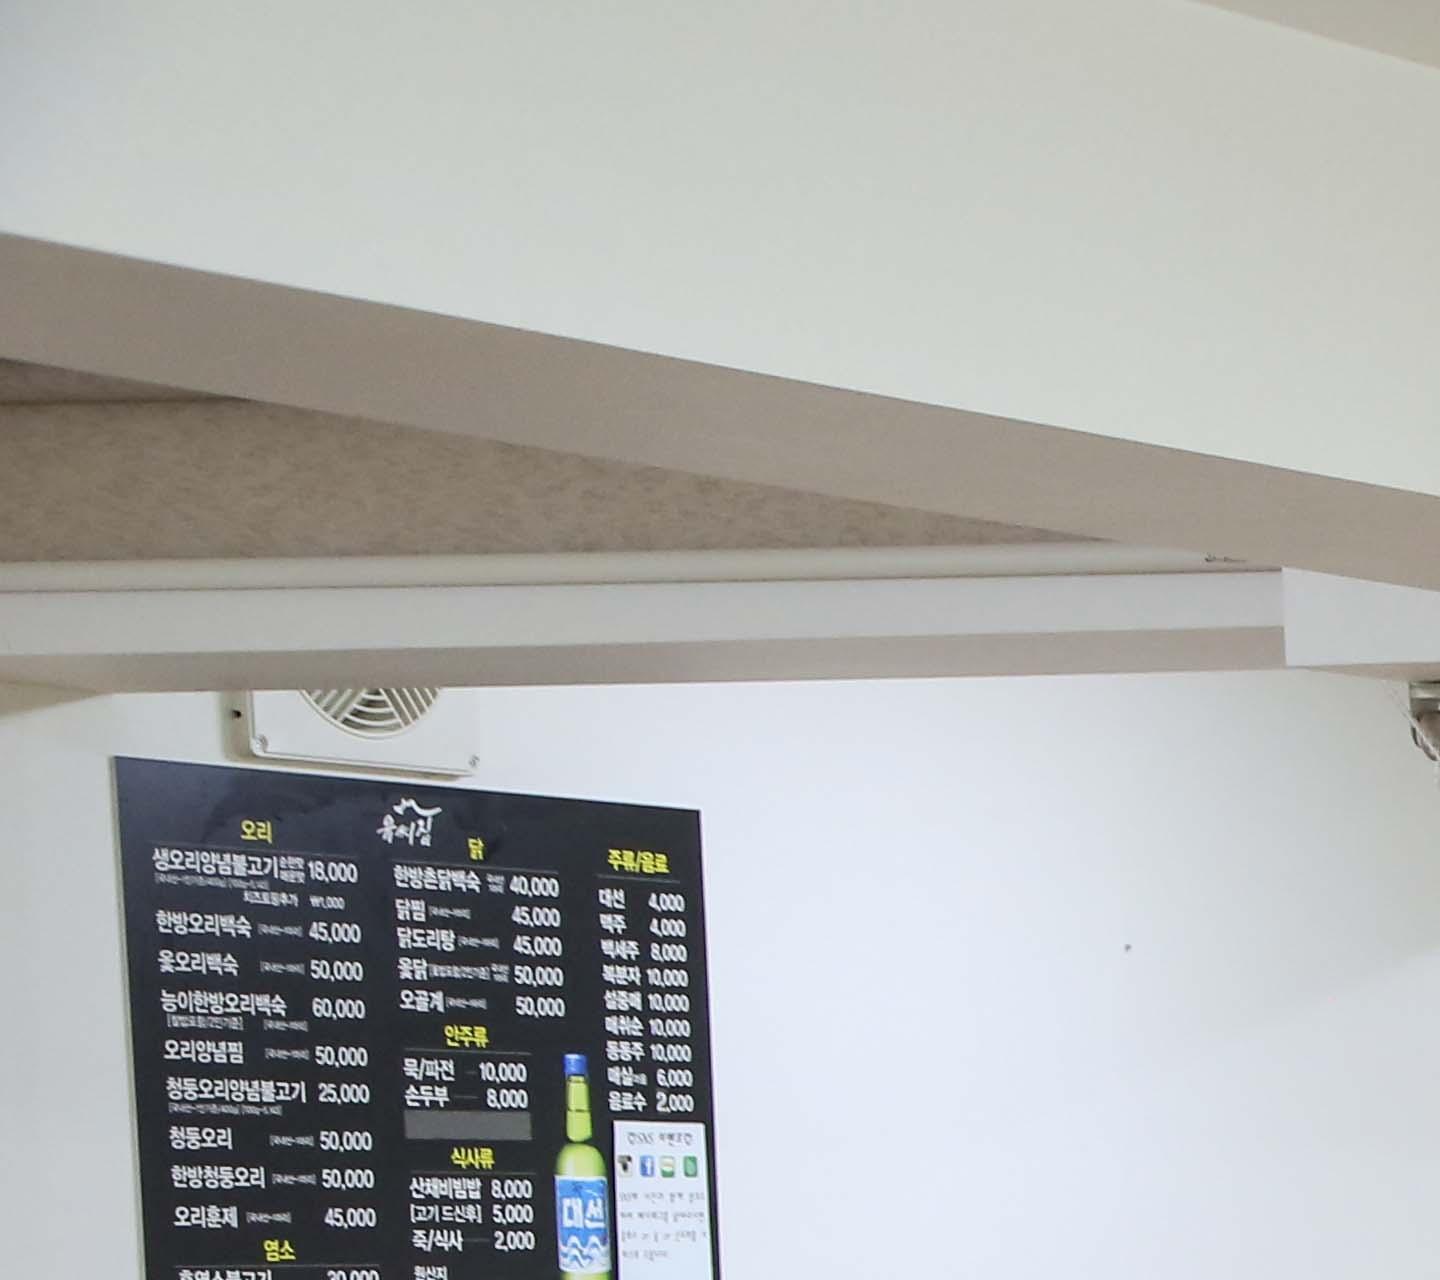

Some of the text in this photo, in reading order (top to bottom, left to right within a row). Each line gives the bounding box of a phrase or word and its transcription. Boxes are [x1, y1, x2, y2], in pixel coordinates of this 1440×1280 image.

[240, 819, 273, 844] 오리
[467, 836, 486, 861] 닭
[607, 848, 670, 874] 주류/음료
[152, 847, 278, 878] 생오리양념불고기
[308, 860, 358, 884] 18,000
[393, 864, 481, 894] 한방촌닭백숙
[509, 875, 560, 899] 40,000
[598, 888, 685, 912] 대선 4,000
[395, 898, 427, 922] 닭찜
[511, 905, 561, 928] 45,000
[155, 909, 252, 938] 한방오리백숙
[308, 921, 362, 944] 45,000
[649, 918, 687, 938] 4,000
[397, 926, 456, 952] 닭도리탕
[513, 935, 563, 957] 45,000
[650, 942, 688, 963] 8,000
[158, 949, 239, 976] 옻오리백숙
[310, 959, 364, 982] 50,000
[397, 957, 428, 981] 옻닭
[514, 965, 564, 988] 50,000
[646, 968, 689, 988] 10,000
[160, 989, 366, 1020] 능이한방오리백숙 60,000
[400, 989, 445, 1013] 오골계
[515, 996, 566, 1018] 50,000
[647, 993, 690, 1013] 10,000
[444, 1024, 490, 1048] 안주류
[648, 1018, 691, 1038] 10,000
[164, 1039, 244, 1064] 오리양념찜
[314, 1046, 368, 1068] 50,000
[650, 1043, 692, 1063] 10,000
[402, 1057, 527, 1084] 묵/파전 10,000
[656, 1069, 694, 1088] 6,000
[166, 1076, 371, 1105] 청둥오리양념불고기 25,000
[405, 1085, 529, 1109] 손두부 8,000
[608, 1089, 695, 1113] 음료수 2,000
[169, 1126, 233, 1150] 청둥오리
[319, 1130, 373, 1152] 50,000
[450, 1147, 495, 1169] 식사류
[170, 1164, 266, 1190] 한방청둥오리
[321, 1169, 375, 1190] 50,000
[409, 1176, 532, 1200] 산채비빔밥 8,000
[173, 1205, 238, 1229] 오리훈제
[324, 1207, 377, 1230] 45,000
[410, 1204, 438, 1224] [고기
[492, 1204, 534, 1225] 5,000
[562, 1197, 606, 1229] 대선
[263, 1239, 296, 1263] 염소
[412, 1229, 536, 1252] 죽/식사 2,000
